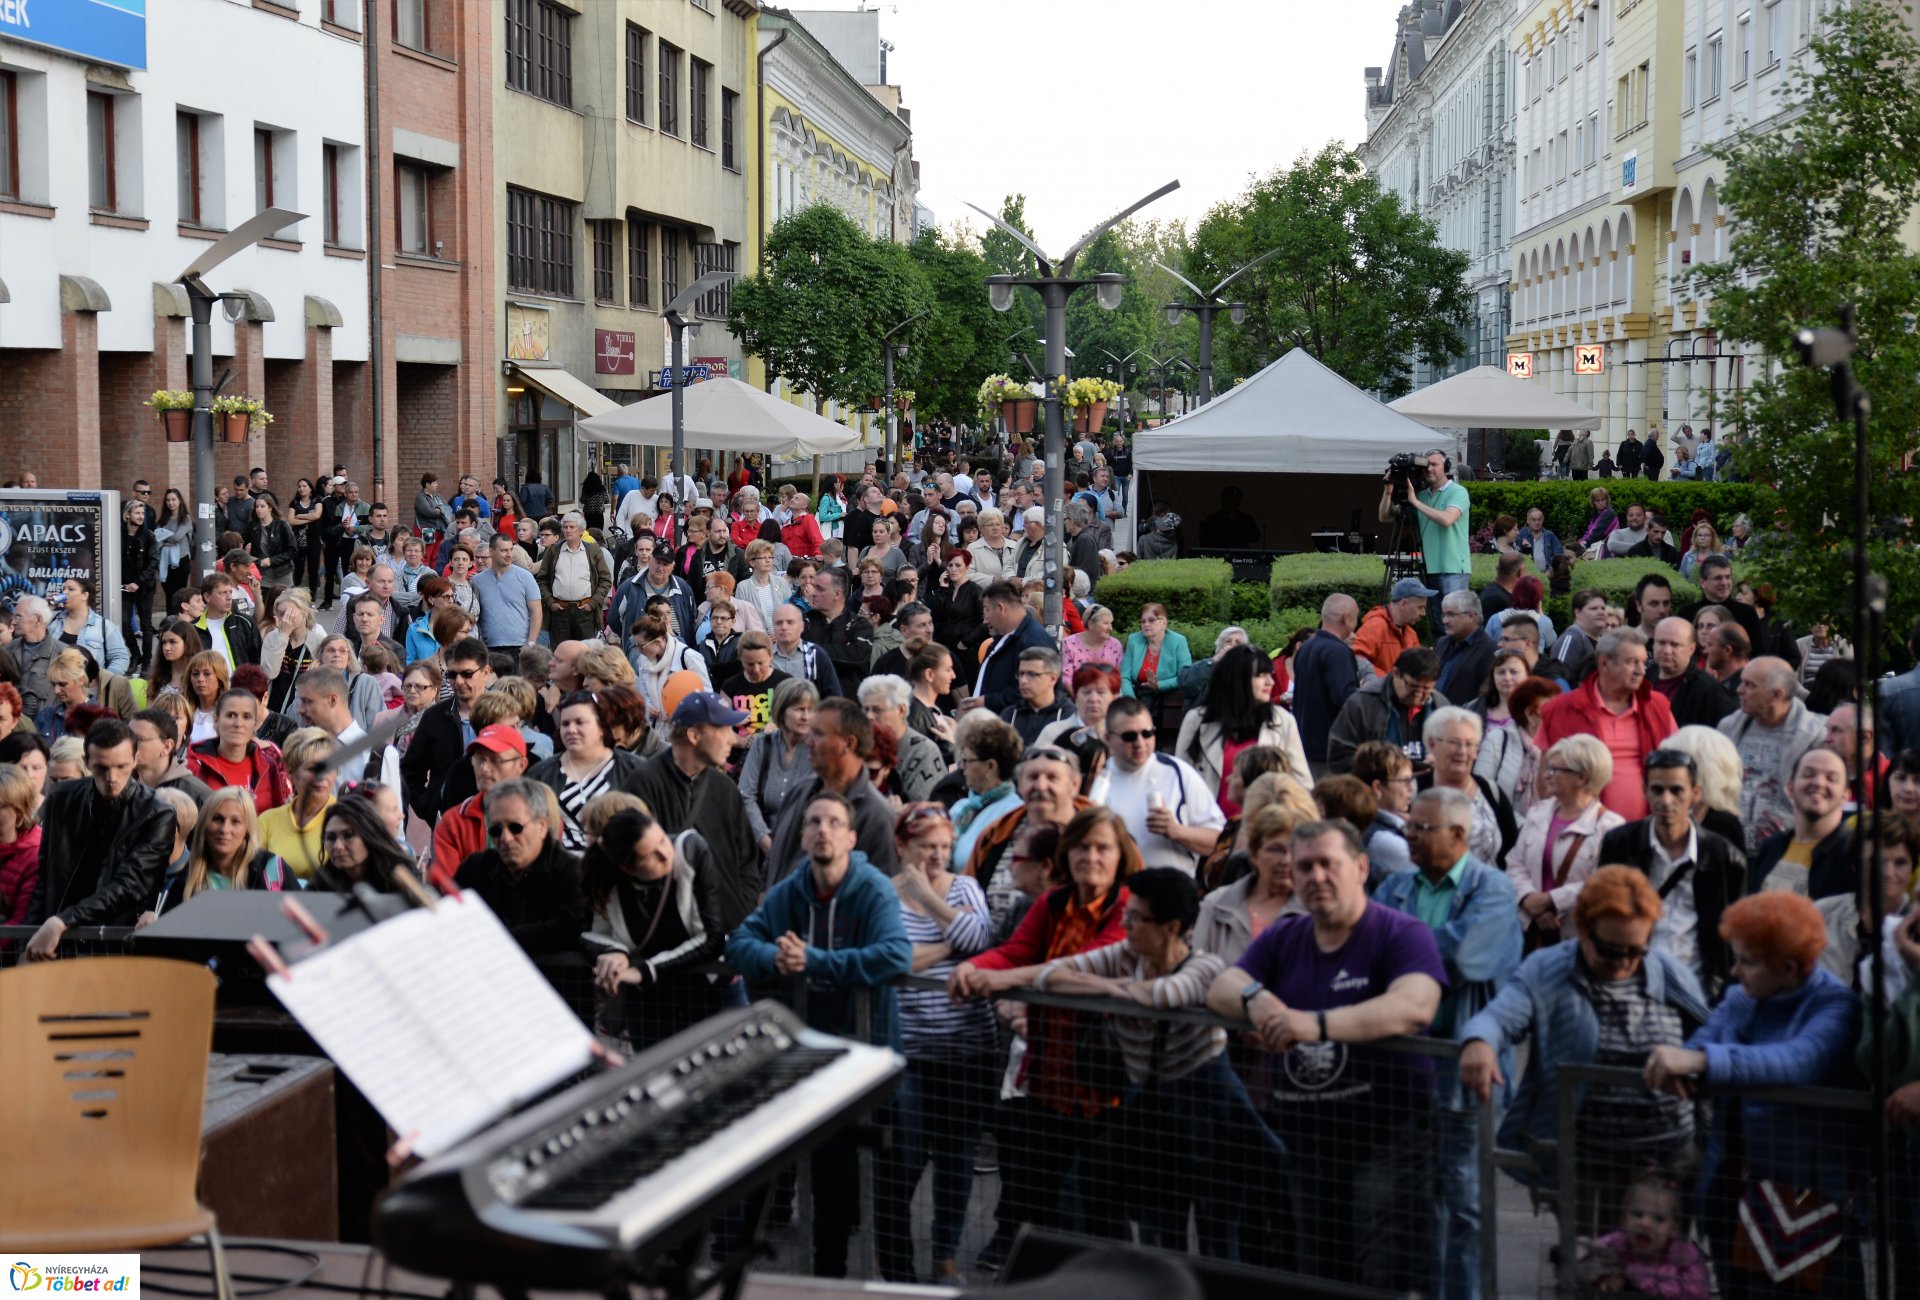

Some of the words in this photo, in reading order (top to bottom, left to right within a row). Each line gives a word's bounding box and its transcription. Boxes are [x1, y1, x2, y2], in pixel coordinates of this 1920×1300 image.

[1583, 354, 1595, 364] M
[1515, 361, 1525, 370] M
[16, 524, 86, 542] APACS
[28, 566, 90, 579] BALLAGÁSRA
[47, 582, 64, 593] ME
